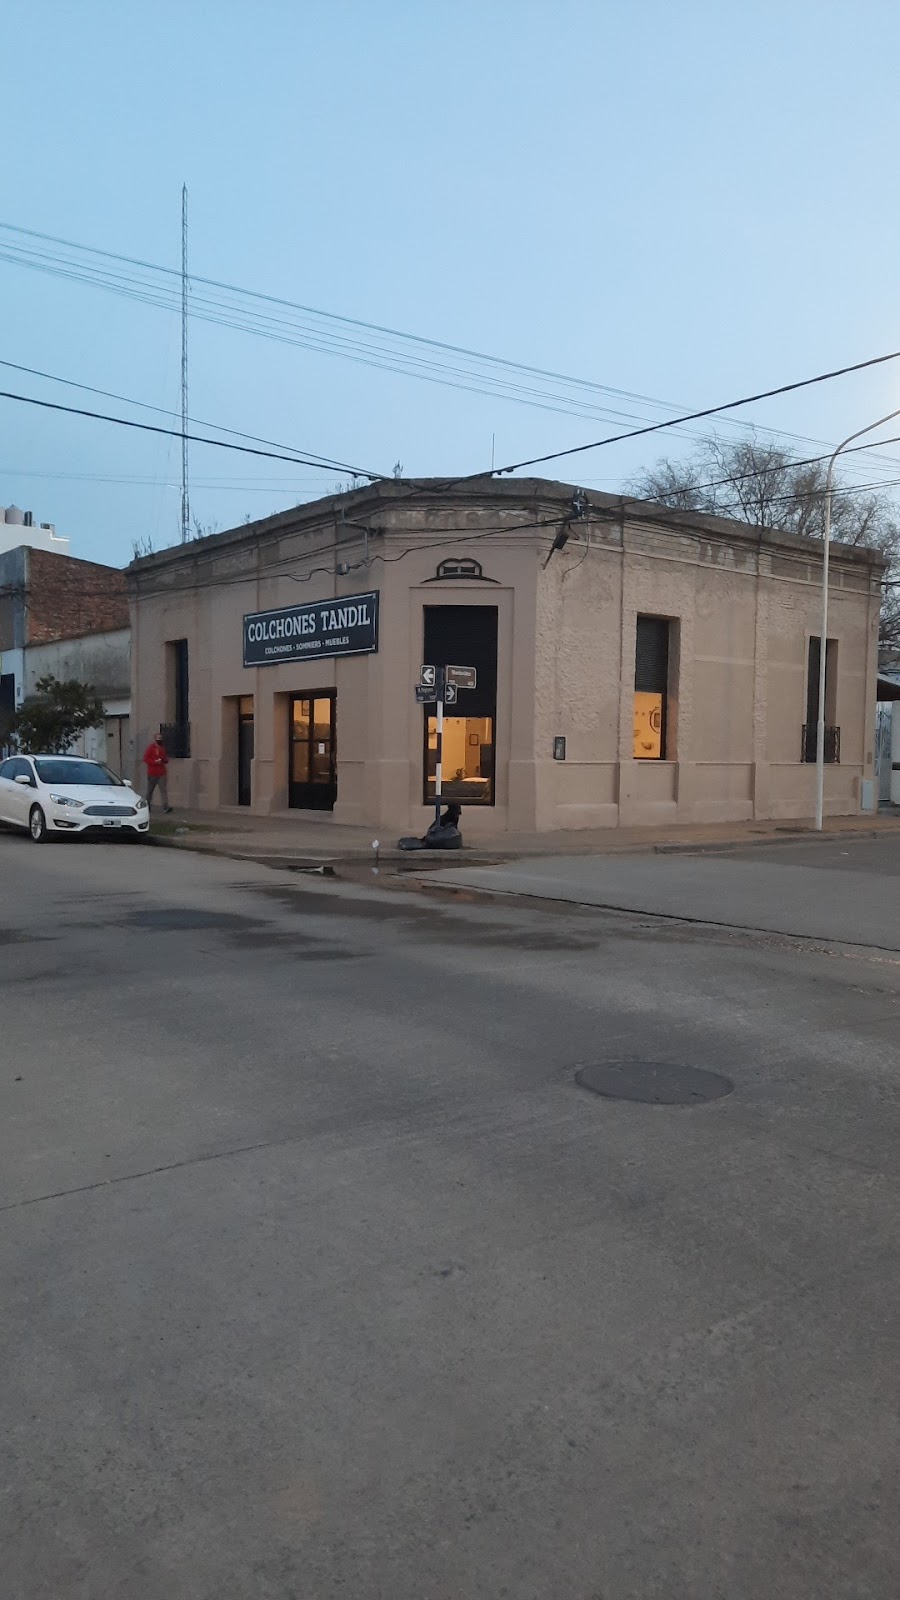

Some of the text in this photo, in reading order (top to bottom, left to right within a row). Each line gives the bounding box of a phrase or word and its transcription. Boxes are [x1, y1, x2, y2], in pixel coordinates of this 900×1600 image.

[248, 604, 370, 642] COLCHONES TANDIL
[264, 636, 349, 654] COLCHONES SOMMIERS MUEBLES
